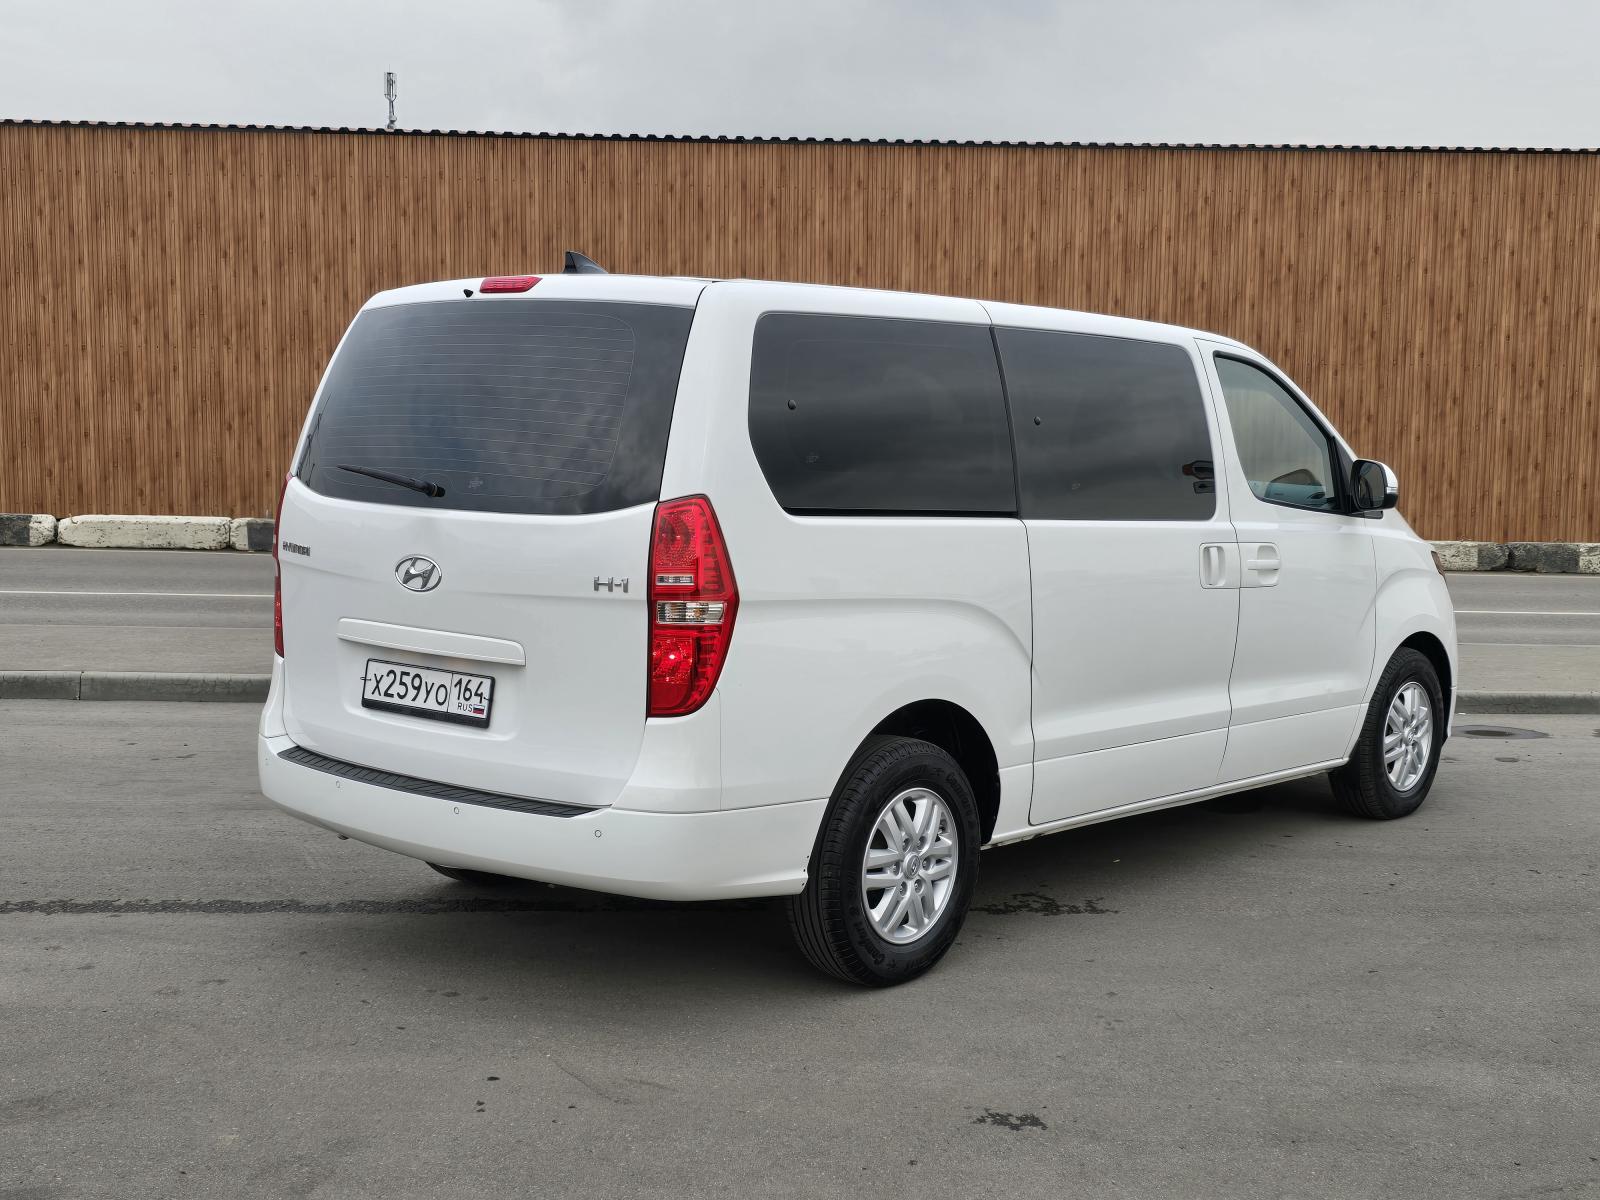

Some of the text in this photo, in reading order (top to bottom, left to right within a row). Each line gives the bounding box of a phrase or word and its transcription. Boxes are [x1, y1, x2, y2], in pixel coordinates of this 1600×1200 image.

[593, 575, 629, 593] H-1
[454, 677, 484, 704] 164
[457, 702, 473, 712] RUS
